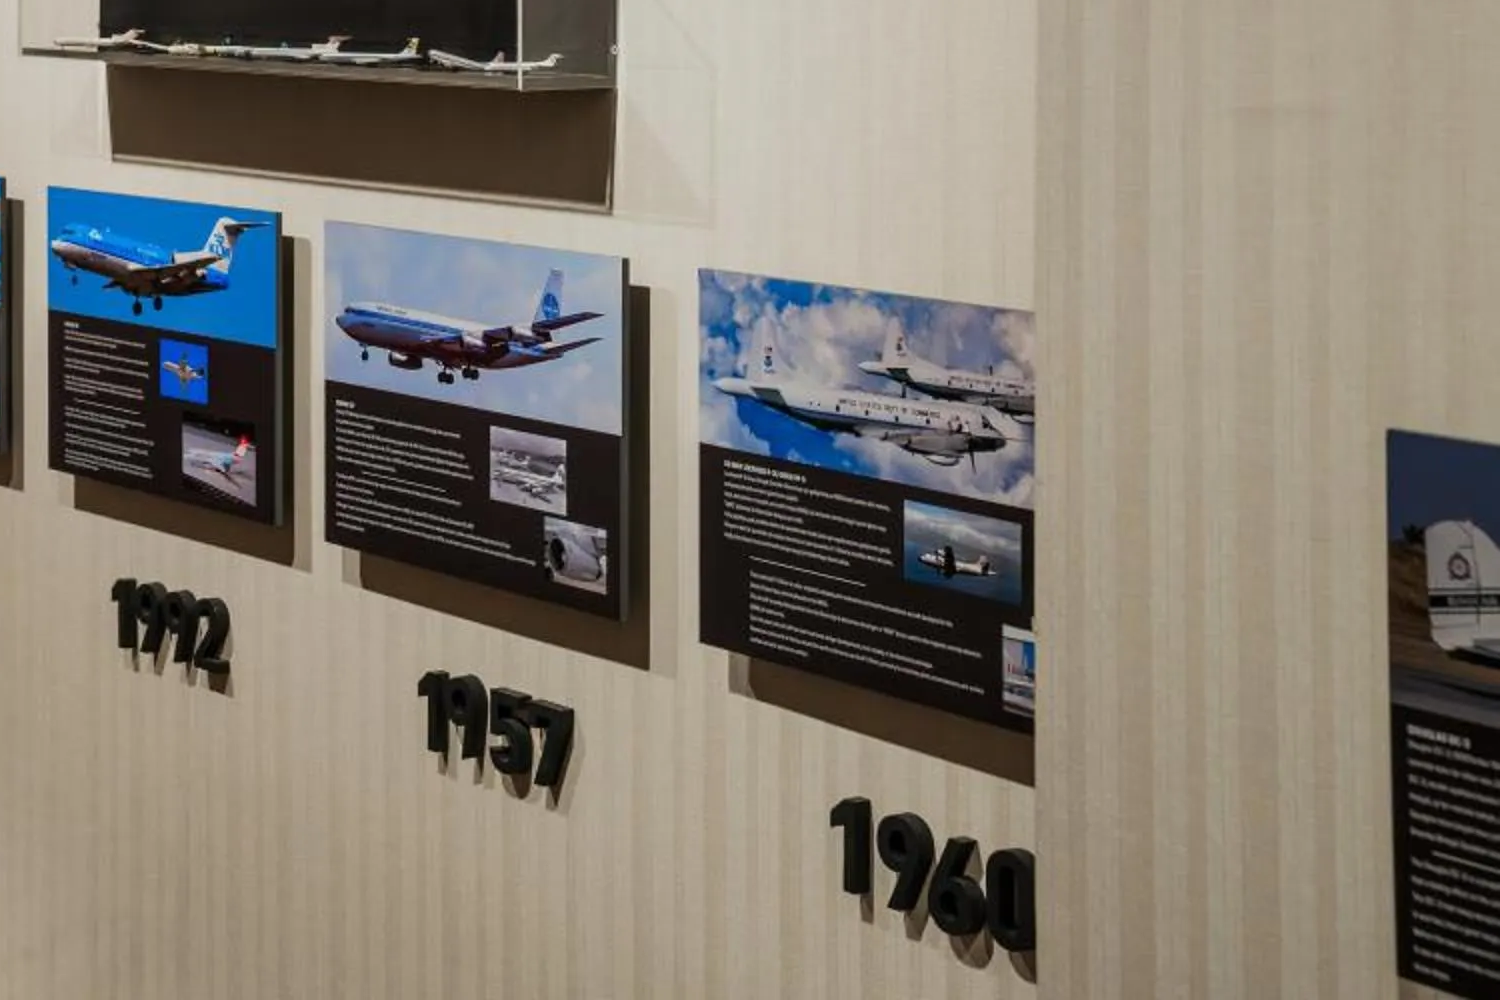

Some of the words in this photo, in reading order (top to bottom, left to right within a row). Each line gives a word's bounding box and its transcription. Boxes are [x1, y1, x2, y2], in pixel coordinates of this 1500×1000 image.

[112, 579, 230, 674] 1992
[418, 671, 574, 787] 1957
[830, 797, 1036, 953] 1960
